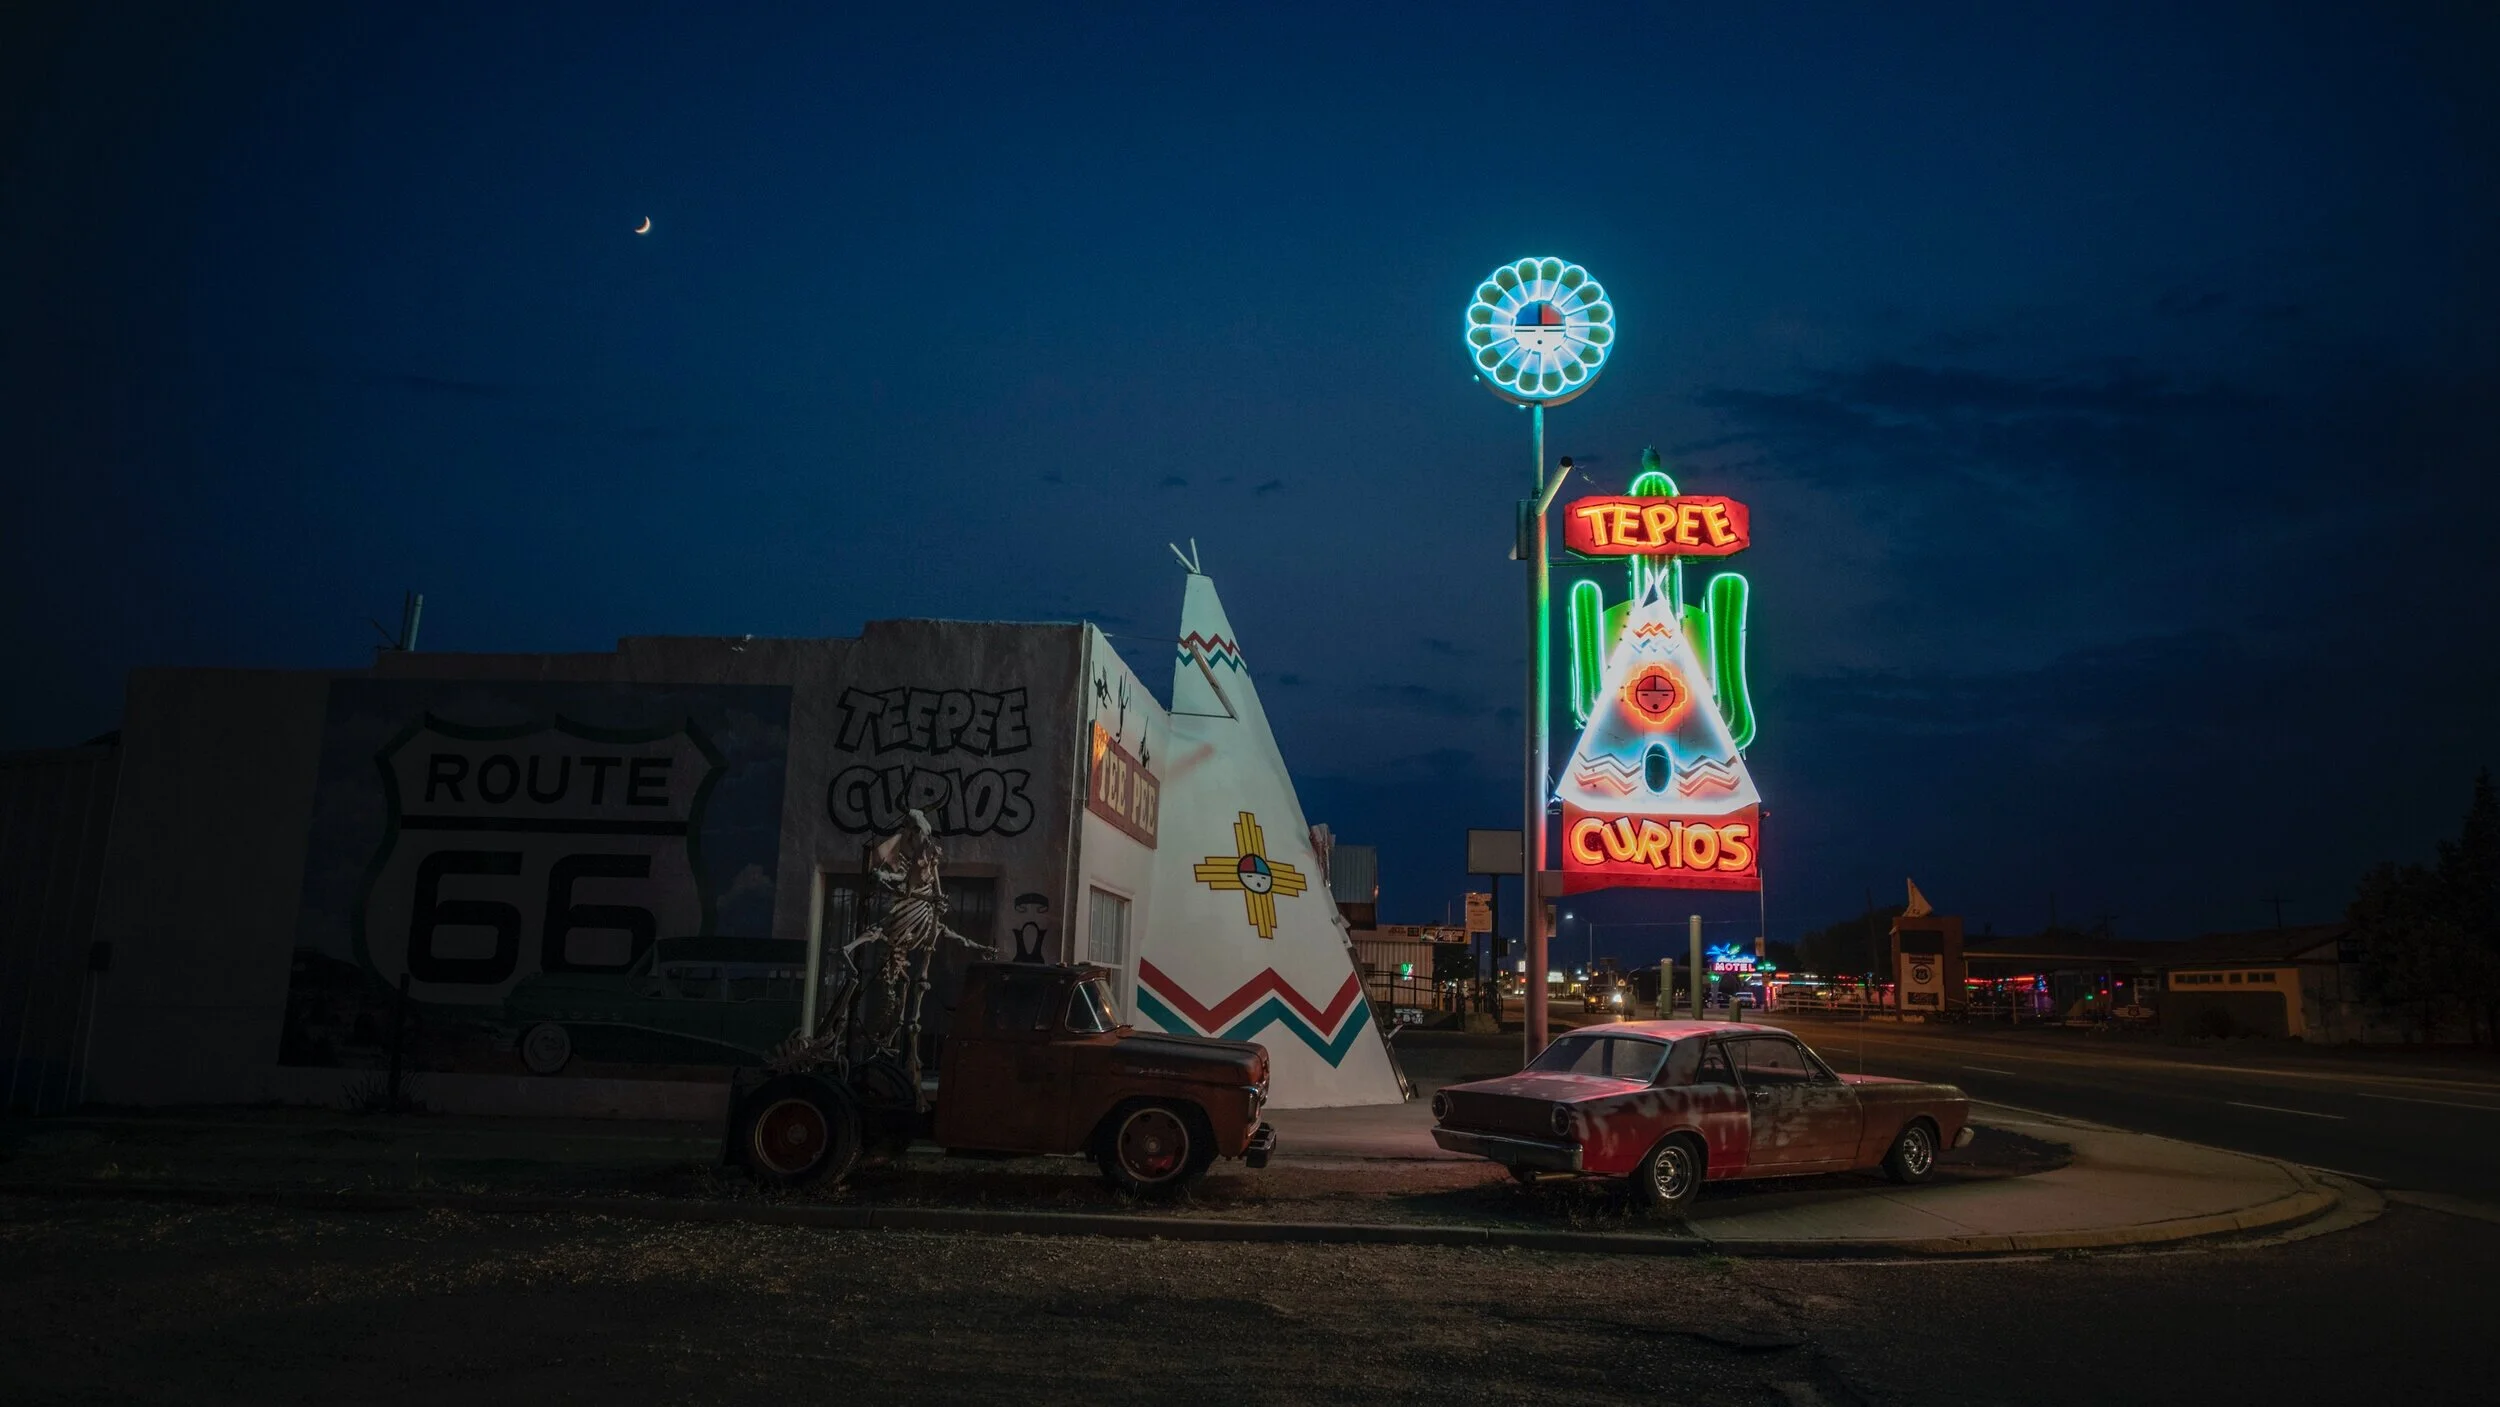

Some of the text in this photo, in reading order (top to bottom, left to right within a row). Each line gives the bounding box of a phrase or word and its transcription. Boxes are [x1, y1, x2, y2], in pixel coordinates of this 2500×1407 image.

[1576, 502, 1738, 548] TEPEE
[834, 686, 1033, 757] TEEPEE
[425, 753, 673, 806] ROUTE
[827, 765, 1035, 837] CURIOS
[1099, 744, 1157, 836] TEE PEE
[1570, 816, 1753, 871] CURIOS
[407, 850, 657, 984] 66
[1715, 962, 1756, 972] MOTEL
